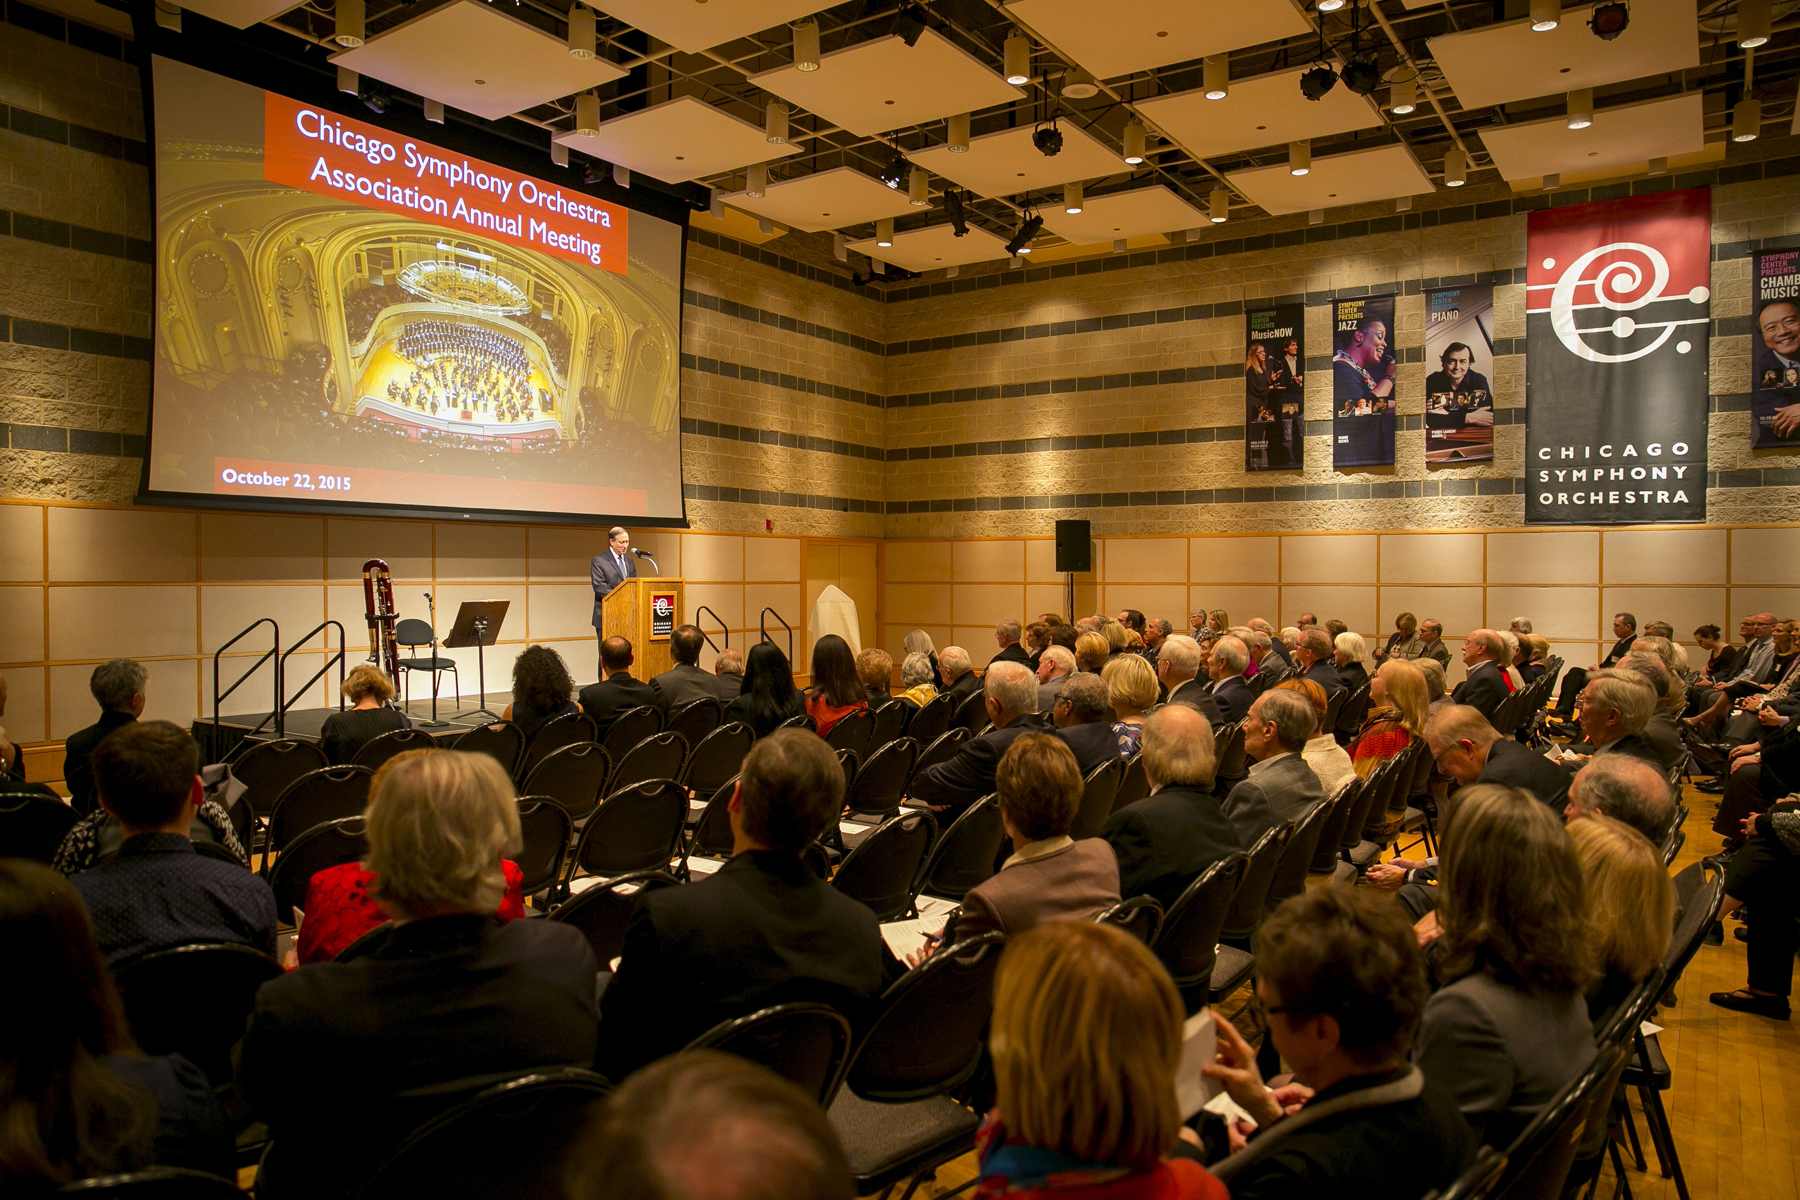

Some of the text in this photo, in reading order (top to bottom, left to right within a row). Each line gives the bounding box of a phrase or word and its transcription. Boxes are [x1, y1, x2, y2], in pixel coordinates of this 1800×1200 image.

[296, 109, 611, 228] Chicago Symphony Orchestra
[310, 156, 602, 265] Association Annual Meeting
[1761, 251, 1800, 263] SYMPHONY
[1761, 260, 1788, 270] CENTER
[1761, 266, 1797, 277] PRESENTS
[1760, 274, 1800, 289] CHAMB
[1431, 290, 1460, 299] SYMPHONY
[1760, 285, 1799, 300] MUSIC
[1338, 300, 1365, 309] SYMPHONY
[1431, 297, 1452, 305] CENTER
[1431, 302, 1459, 311] PRESENTS
[1251, 310, 1277, 319] SYMPHONY
[1338, 307, 1358, 315] CENTER
[1338, 312, 1364, 321] PRESENTS
[1431, 309, 1459, 322] PIANO
[1251, 322, 1275, 330] PRESENTS
[1337, 320, 1358, 332] JAZZ
[1251, 327, 1293, 340] MusicNOW
[1538, 442, 1690, 460] CHICAGO
[221, 468, 352, 491] October 22, 2015
[1539, 465, 1688, 483] SYMPHONY
[1538, 489, 1690, 505] ORCHESTRA
